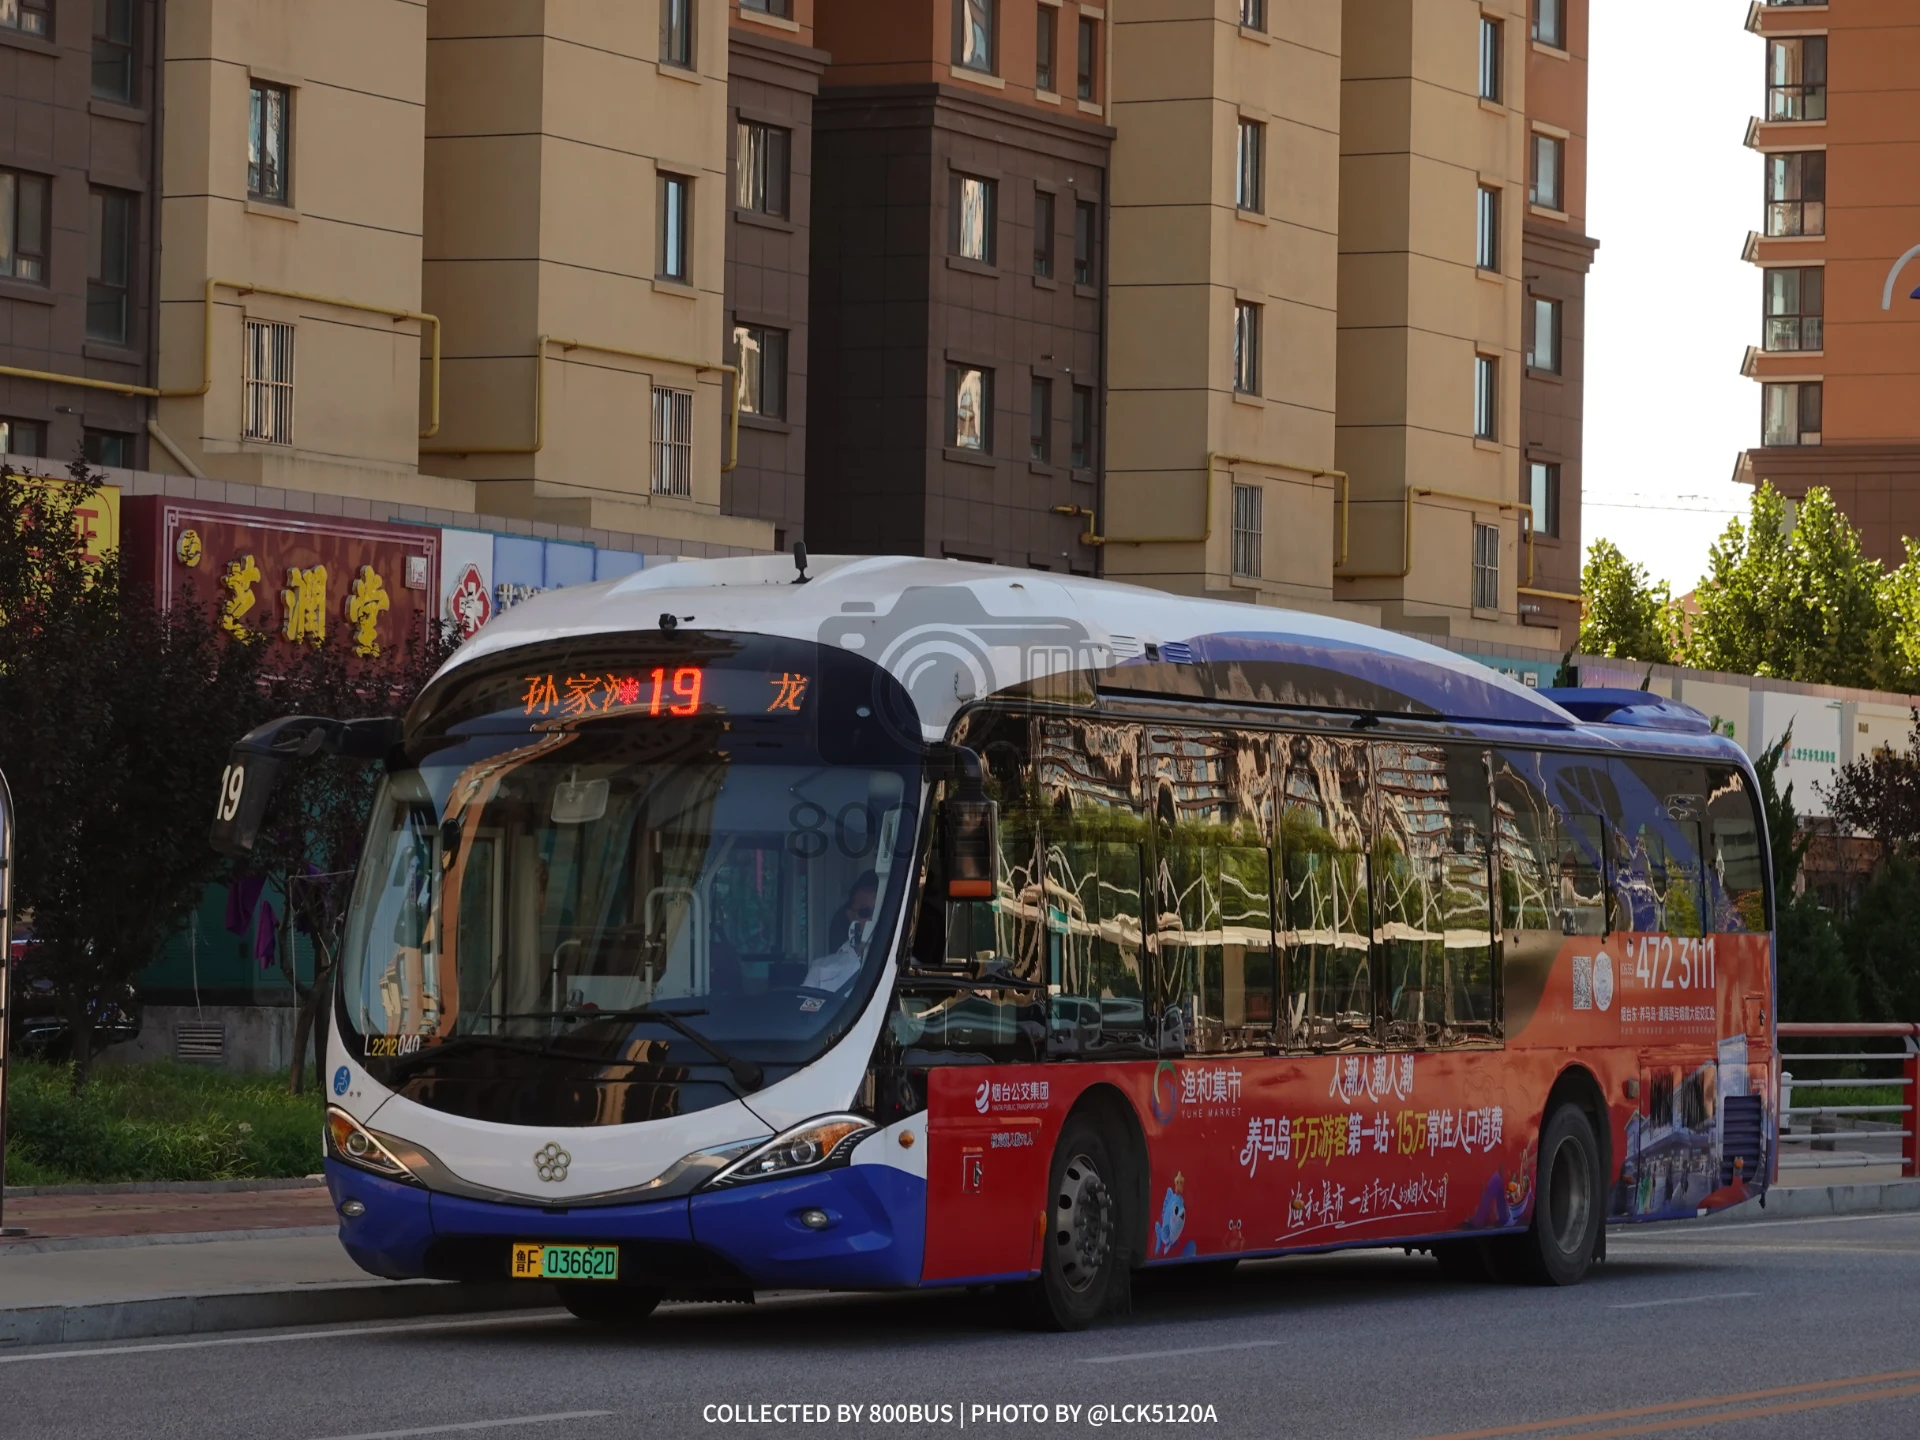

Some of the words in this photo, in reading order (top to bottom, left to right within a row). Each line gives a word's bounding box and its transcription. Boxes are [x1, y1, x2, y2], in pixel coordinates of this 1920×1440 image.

[650, 667, 702, 717] 19
[767, 672, 808, 712] 龙
[217, 765, 244, 821] 19
[1636, 936, 1675, 989] 472
[1678, 937, 1716, 990] 3111
[992, 1081, 1049, 1102] 烟台公交集团
[1181, 1066, 1242, 1104] 渔和集市
[1181, 1109, 1203, 1119] YUHE
[1208, 1107, 1242, 1118] MARKET
[548, 1250, 615, 1275] 03662D
